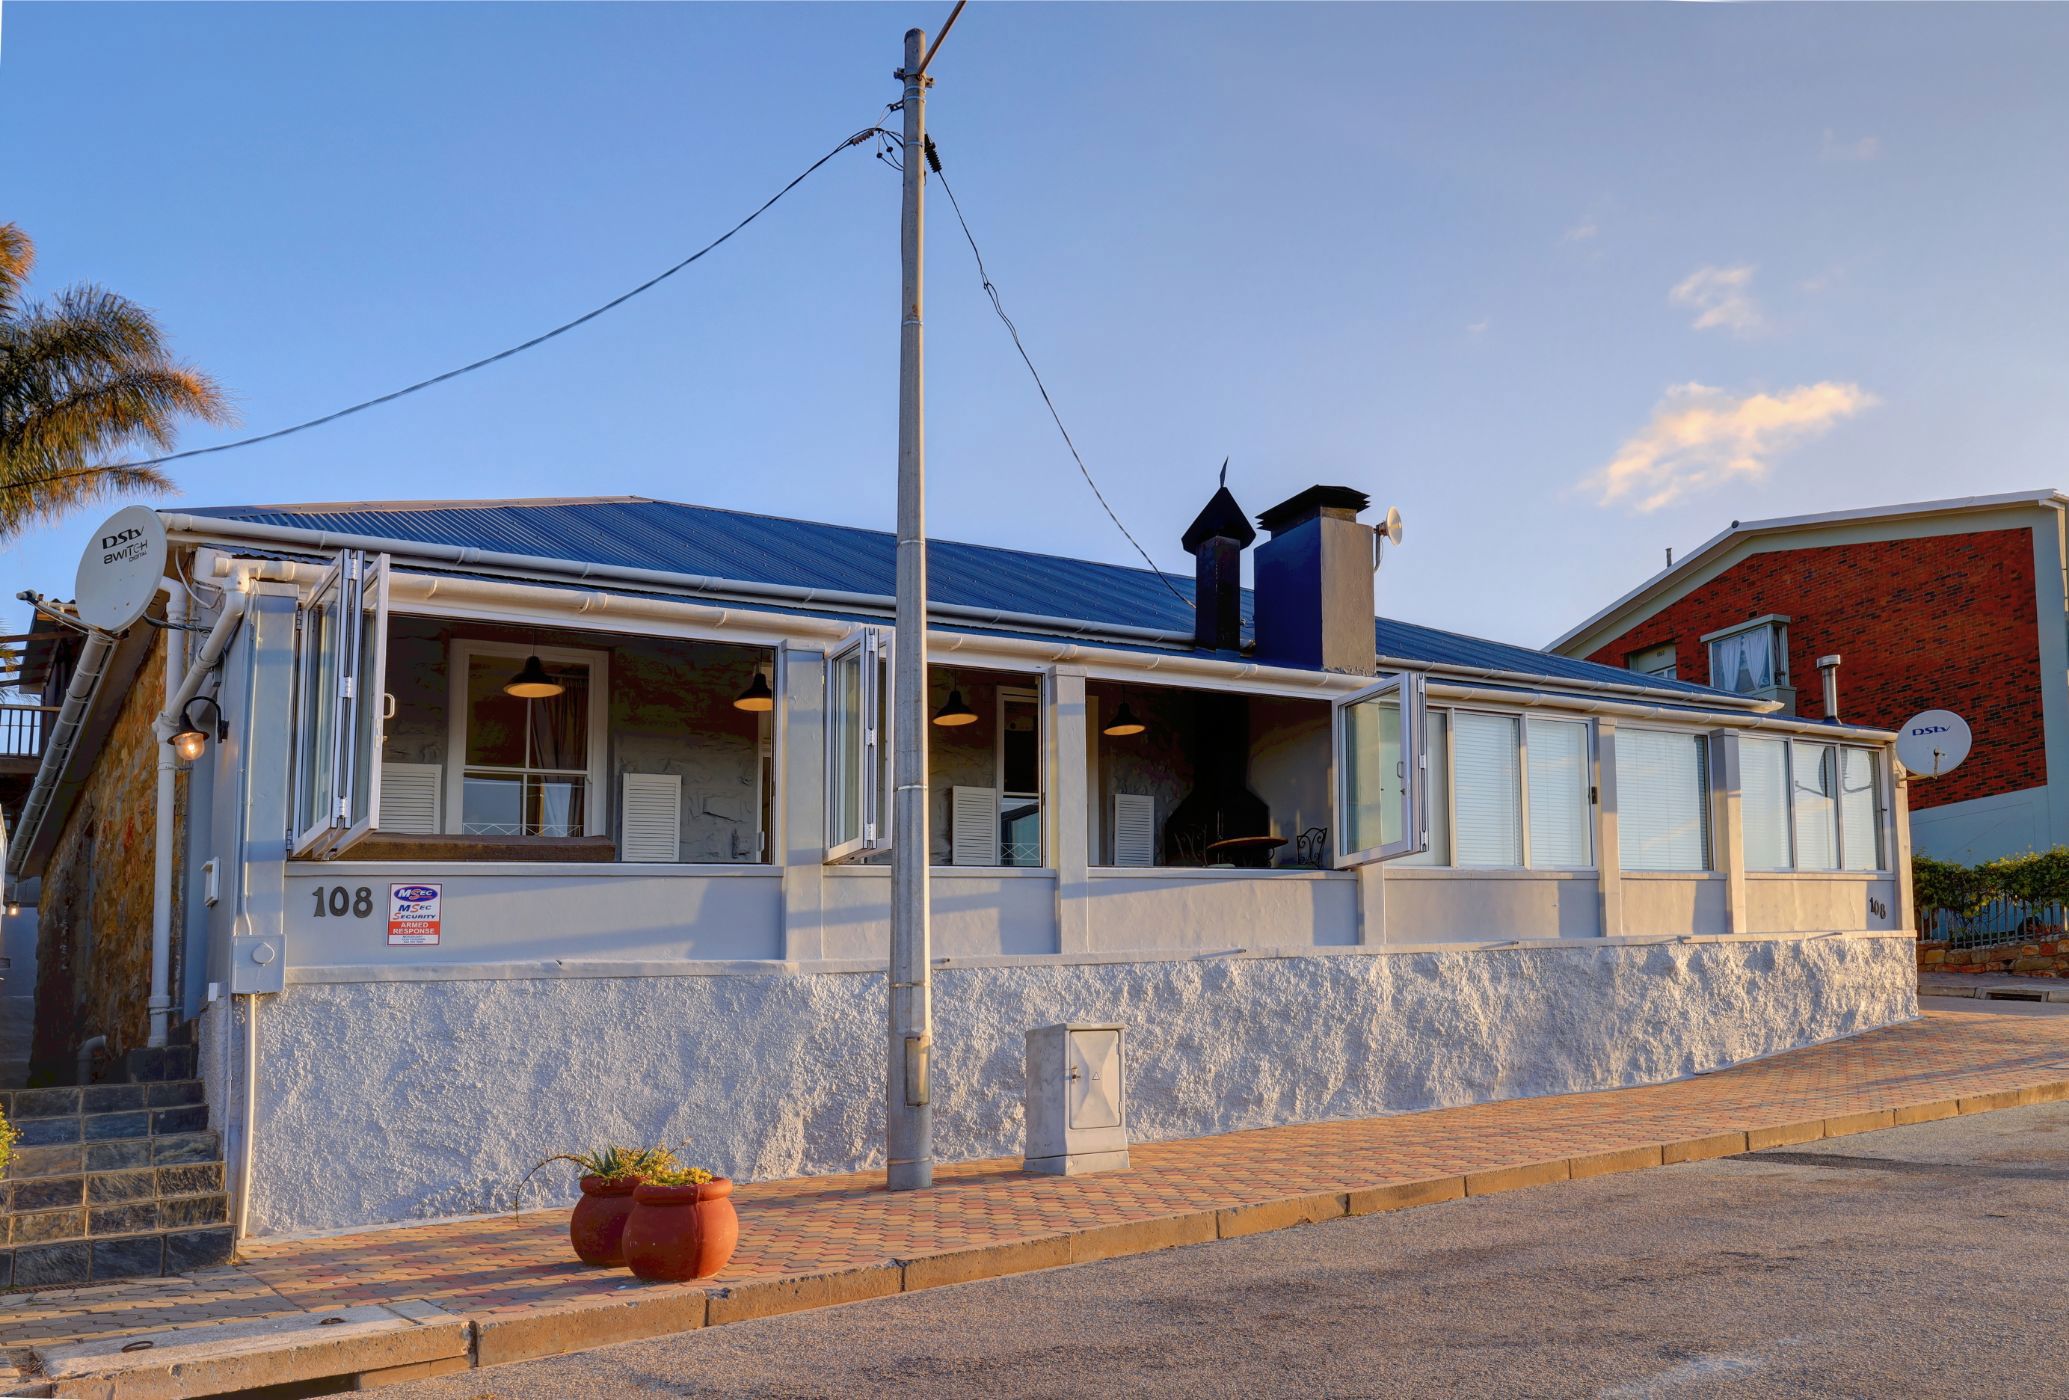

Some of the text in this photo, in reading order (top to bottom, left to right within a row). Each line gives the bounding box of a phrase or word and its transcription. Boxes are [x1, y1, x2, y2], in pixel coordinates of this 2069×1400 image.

[102, 525, 144, 549] DStv
[1912, 725, 1951, 736] DStv
[312, 886, 373, 918] 108
[1869, 896, 1887, 920] 108
